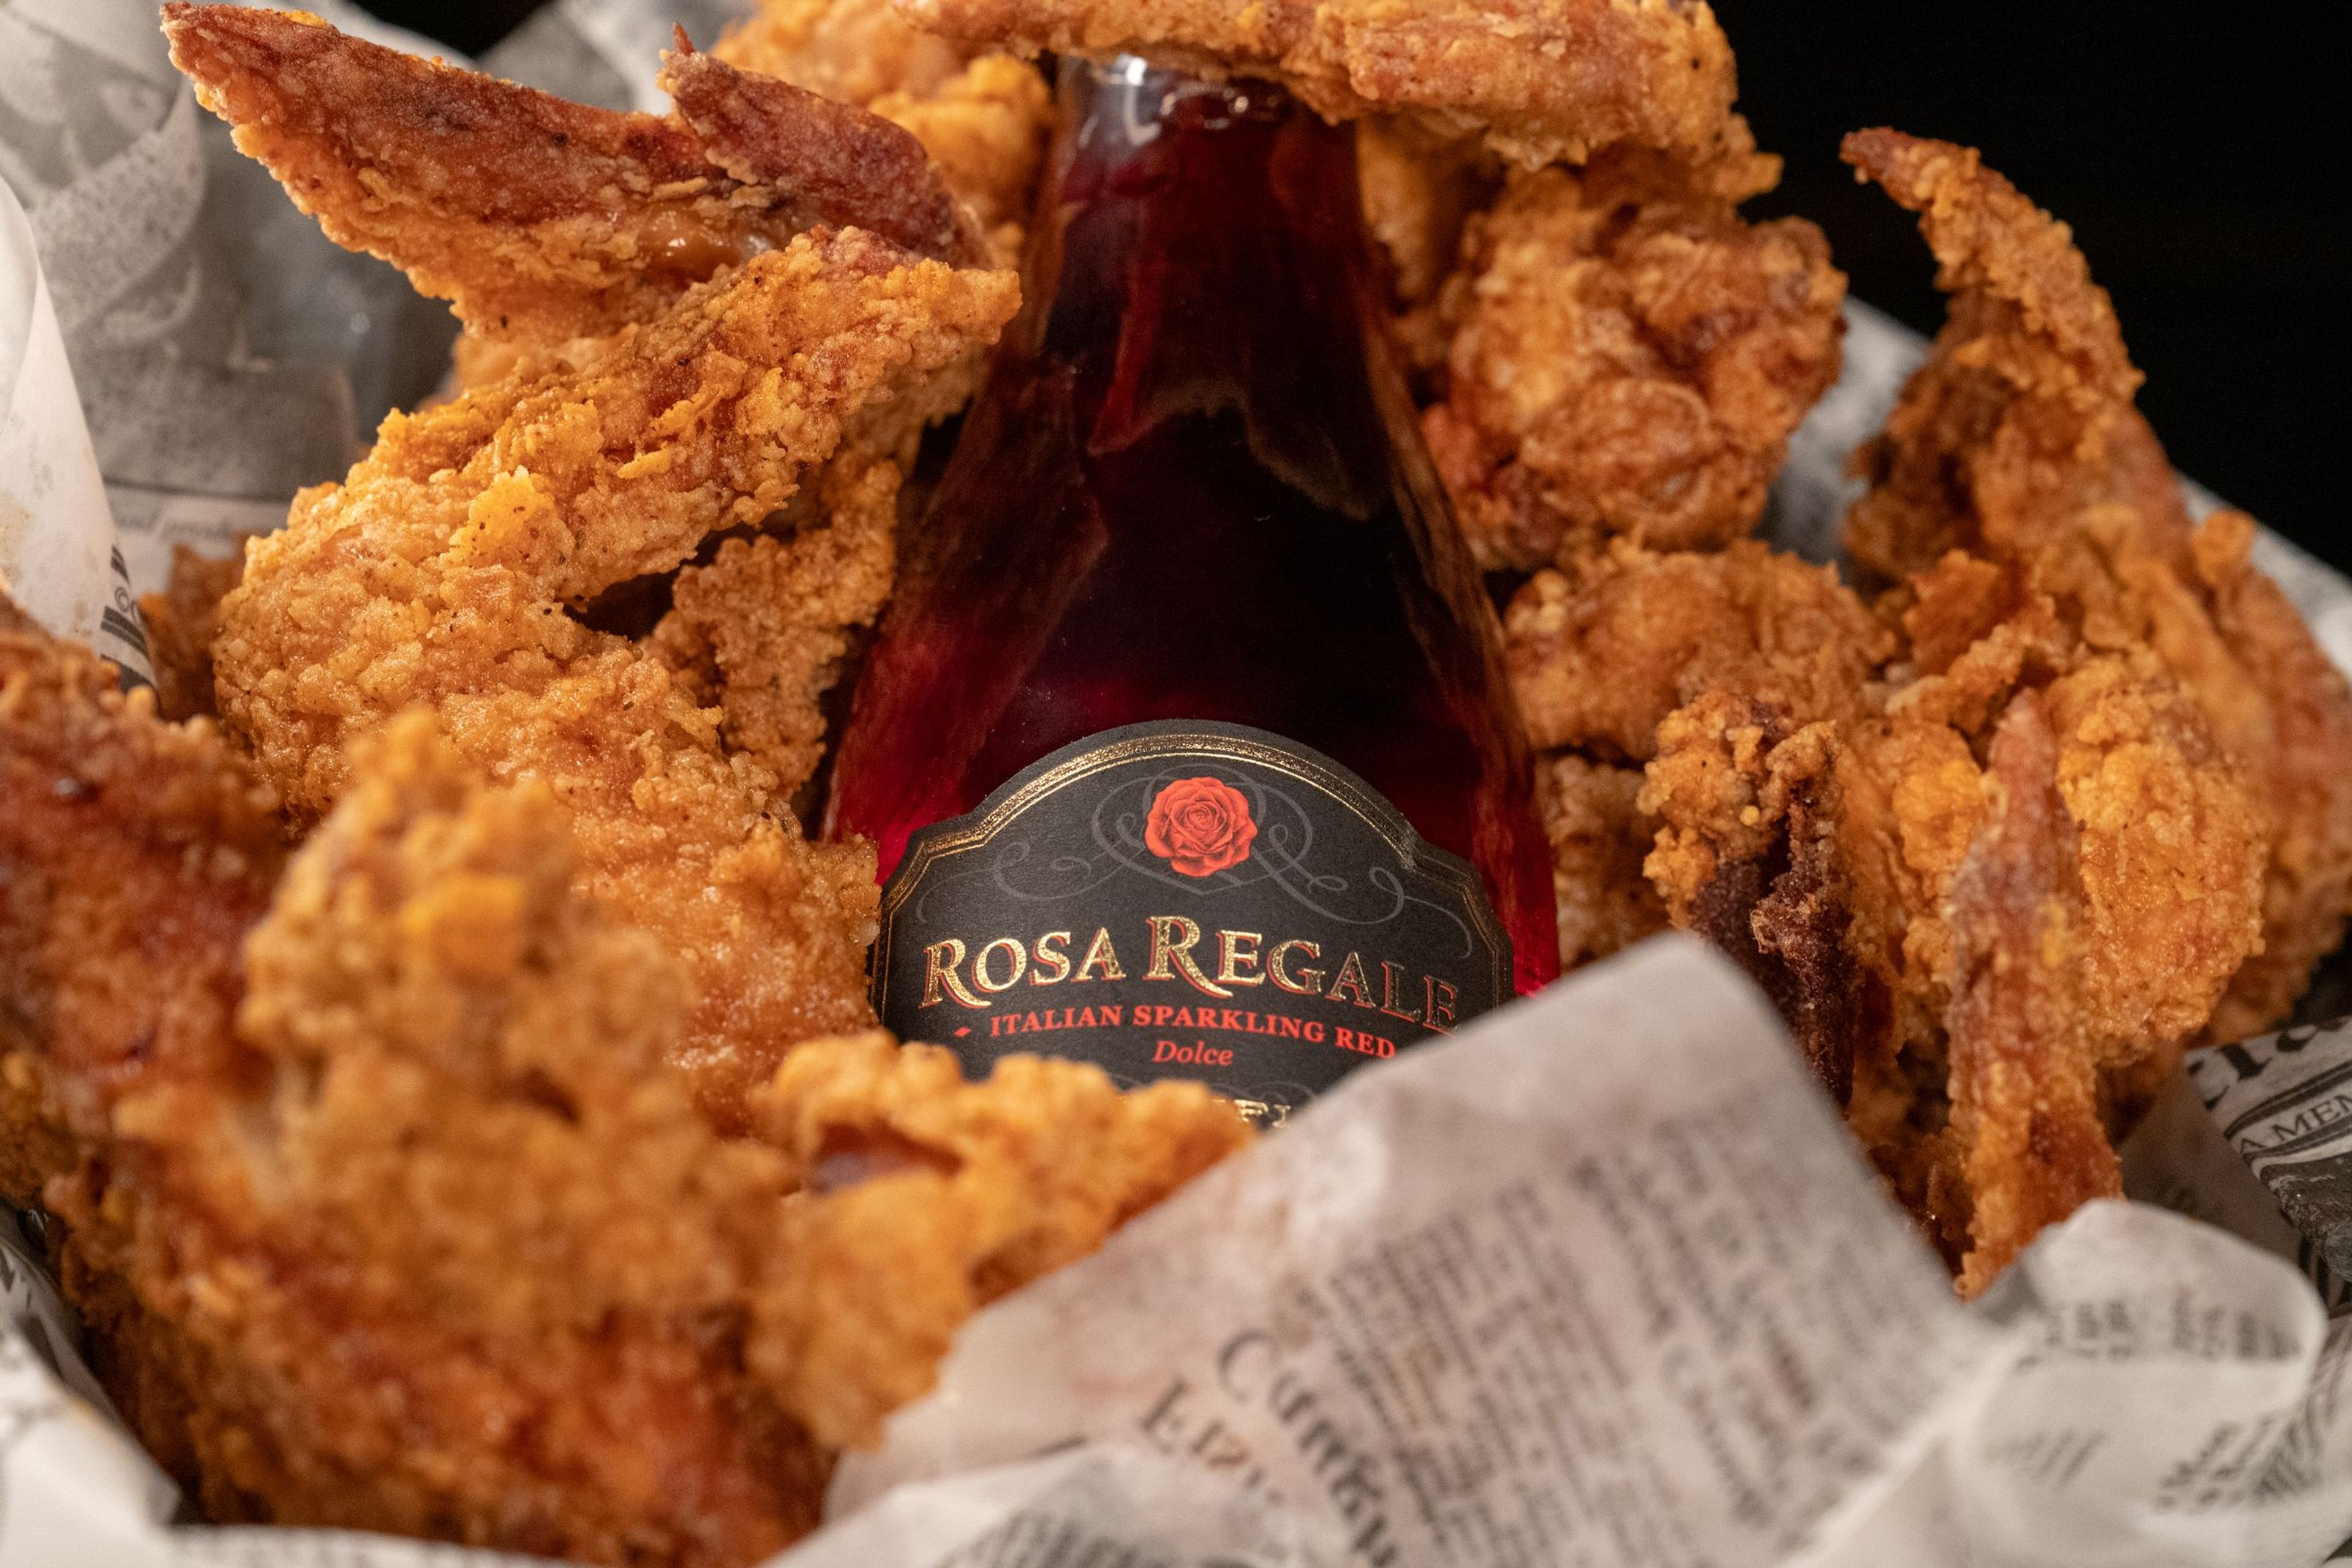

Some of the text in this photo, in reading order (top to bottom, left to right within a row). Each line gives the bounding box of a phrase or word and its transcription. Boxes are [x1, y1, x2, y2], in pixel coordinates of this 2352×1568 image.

[919, 916, 1459, 1037] ROSA REGALE
[990, 1005, 1396, 1060] ITALIAN SPARKLING RED
[1152, 1039, 1234, 1068] Dolce
